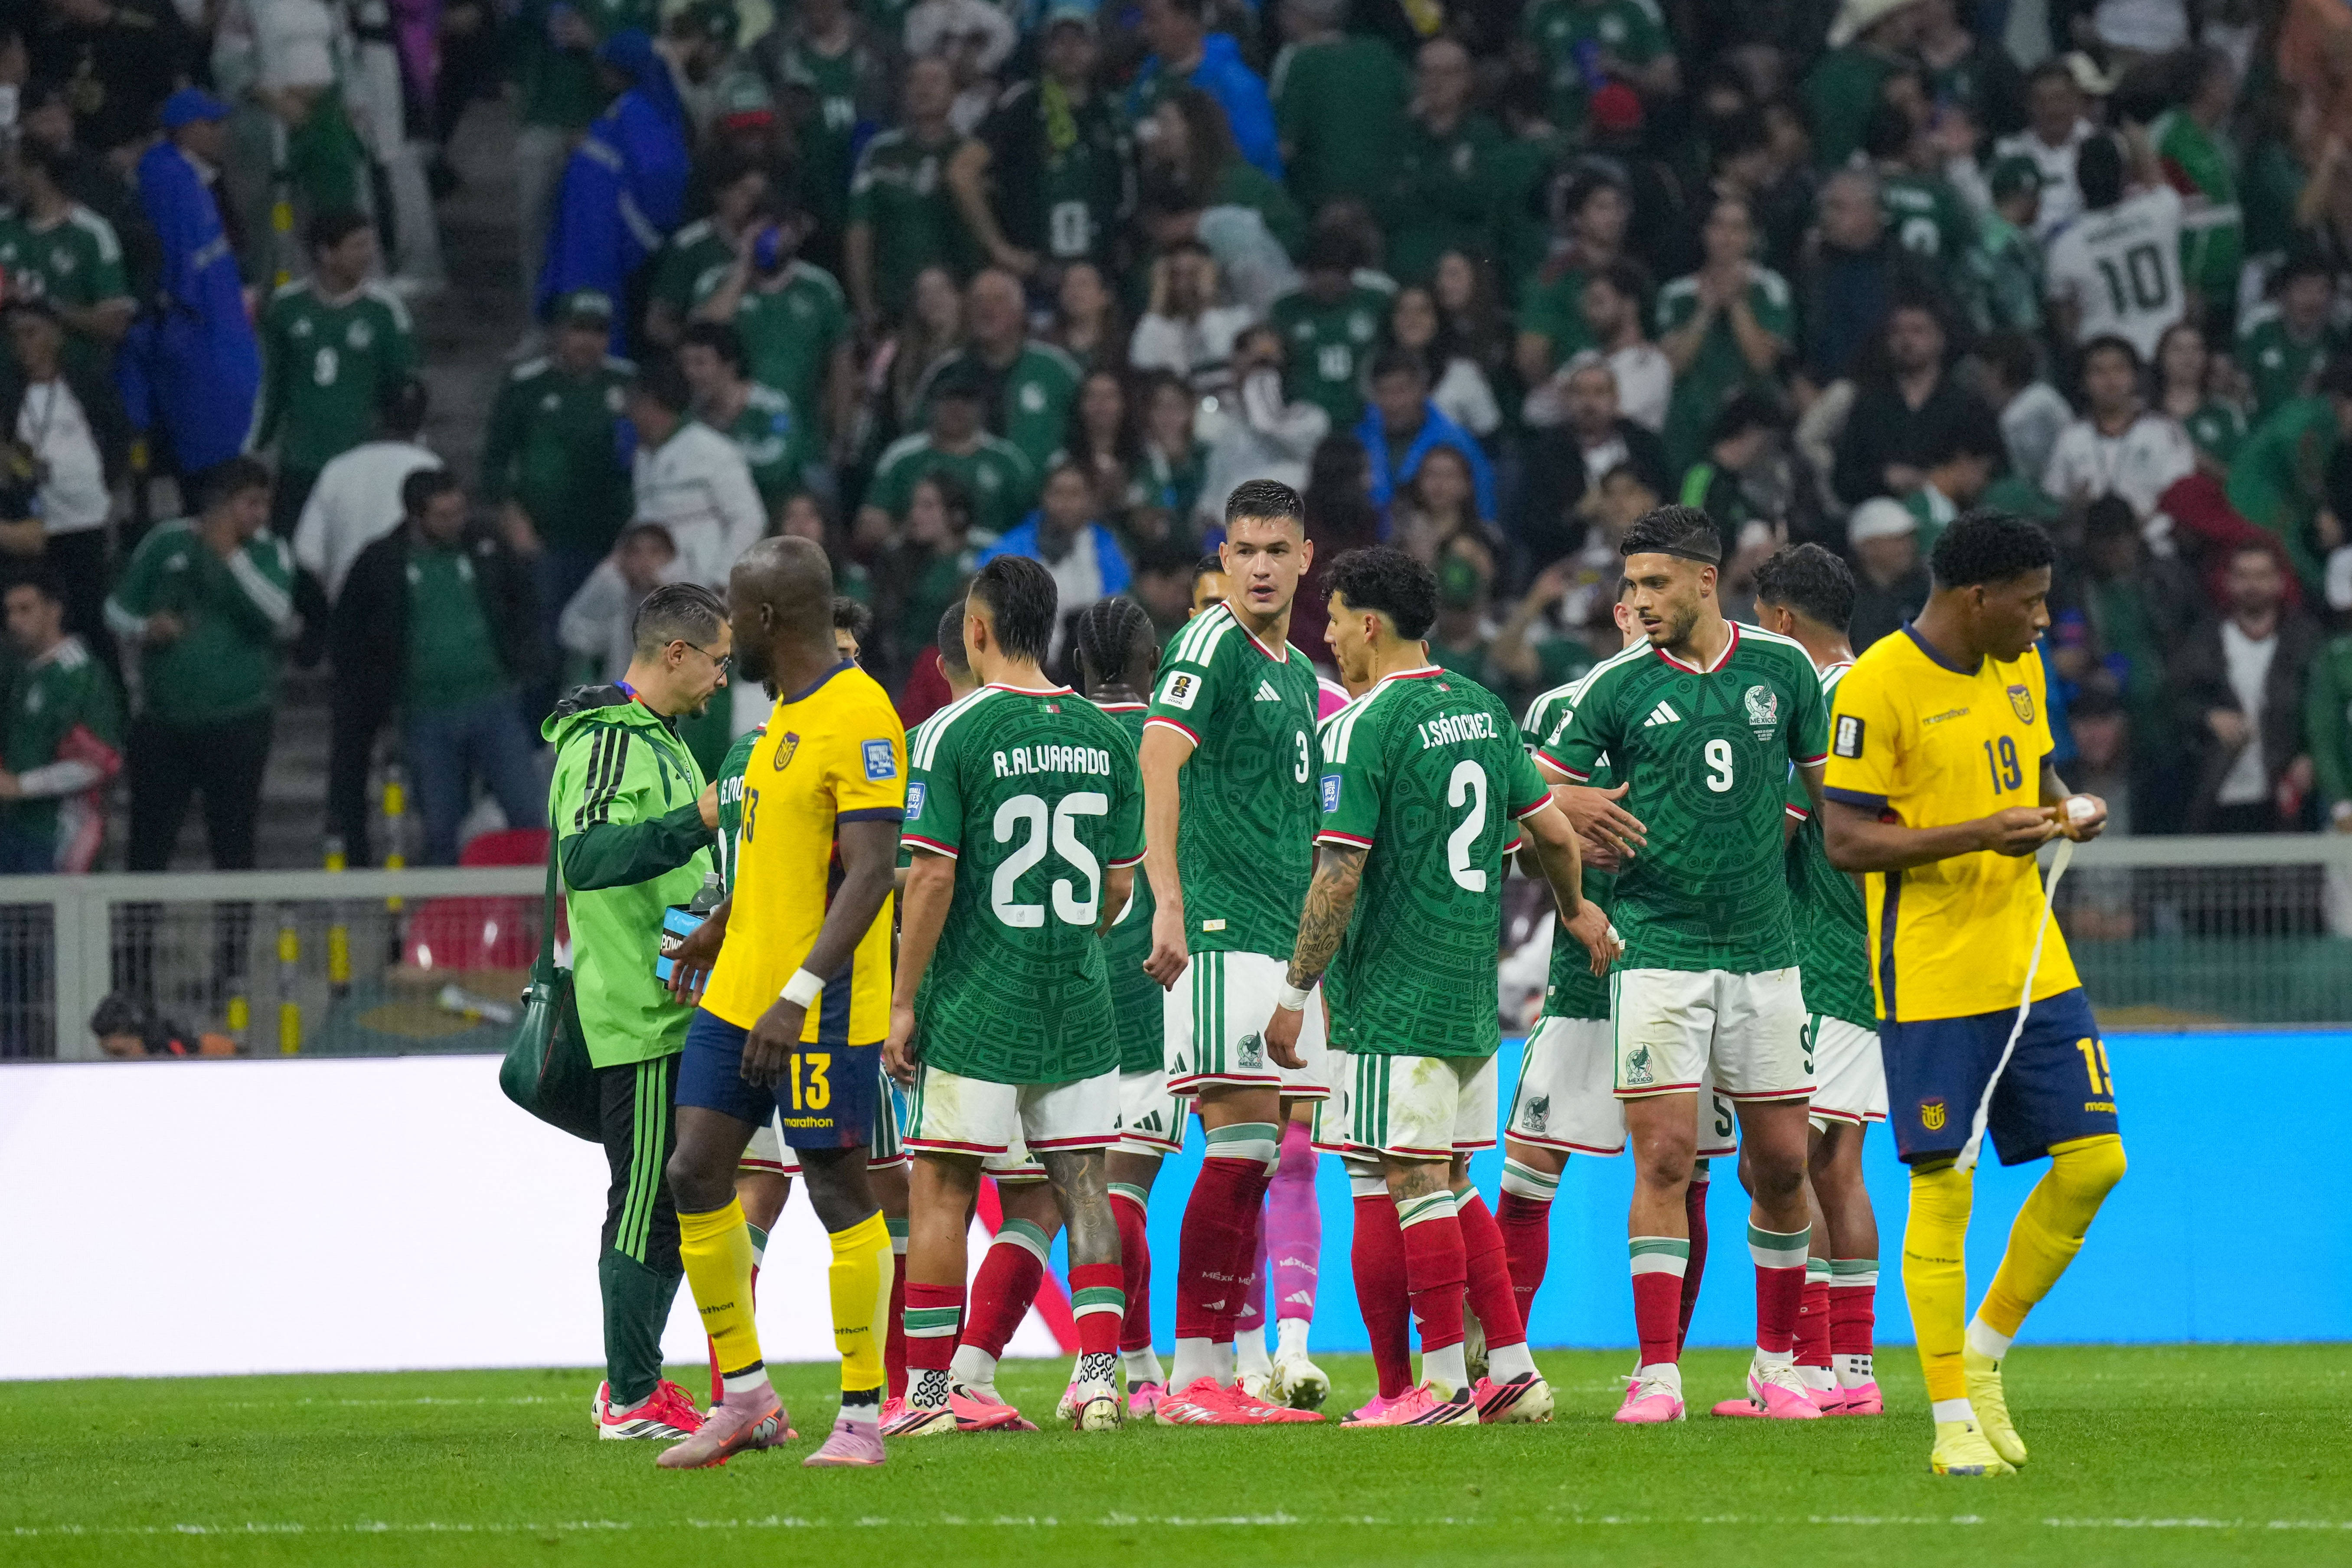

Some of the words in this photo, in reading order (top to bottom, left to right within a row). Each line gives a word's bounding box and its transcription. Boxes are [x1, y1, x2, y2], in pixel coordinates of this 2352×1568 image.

[2097, 236, 2167, 316] 10
[1295, 730, 1309, 784] 3
[1418, 712, 1498, 750] J.SÁNCHEZ
[993, 745, 1110, 778] R.ALVARADO
[1704, 738, 1734, 792] 9
[1984, 736, 2022, 795] 19
[721, 775, 745, 805] G.MO
[741, 786, 759, 843] 13
[1447, 759, 1487, 893] 2
[991, 791, 1109, 928] 25
[790, 1053, 831, 1111] 13
[784, 1116, 834, 1128] marathon
[1279, 1256, 1317, 1276] MÉXICO
[834, 1326, 868, 1334] athon
